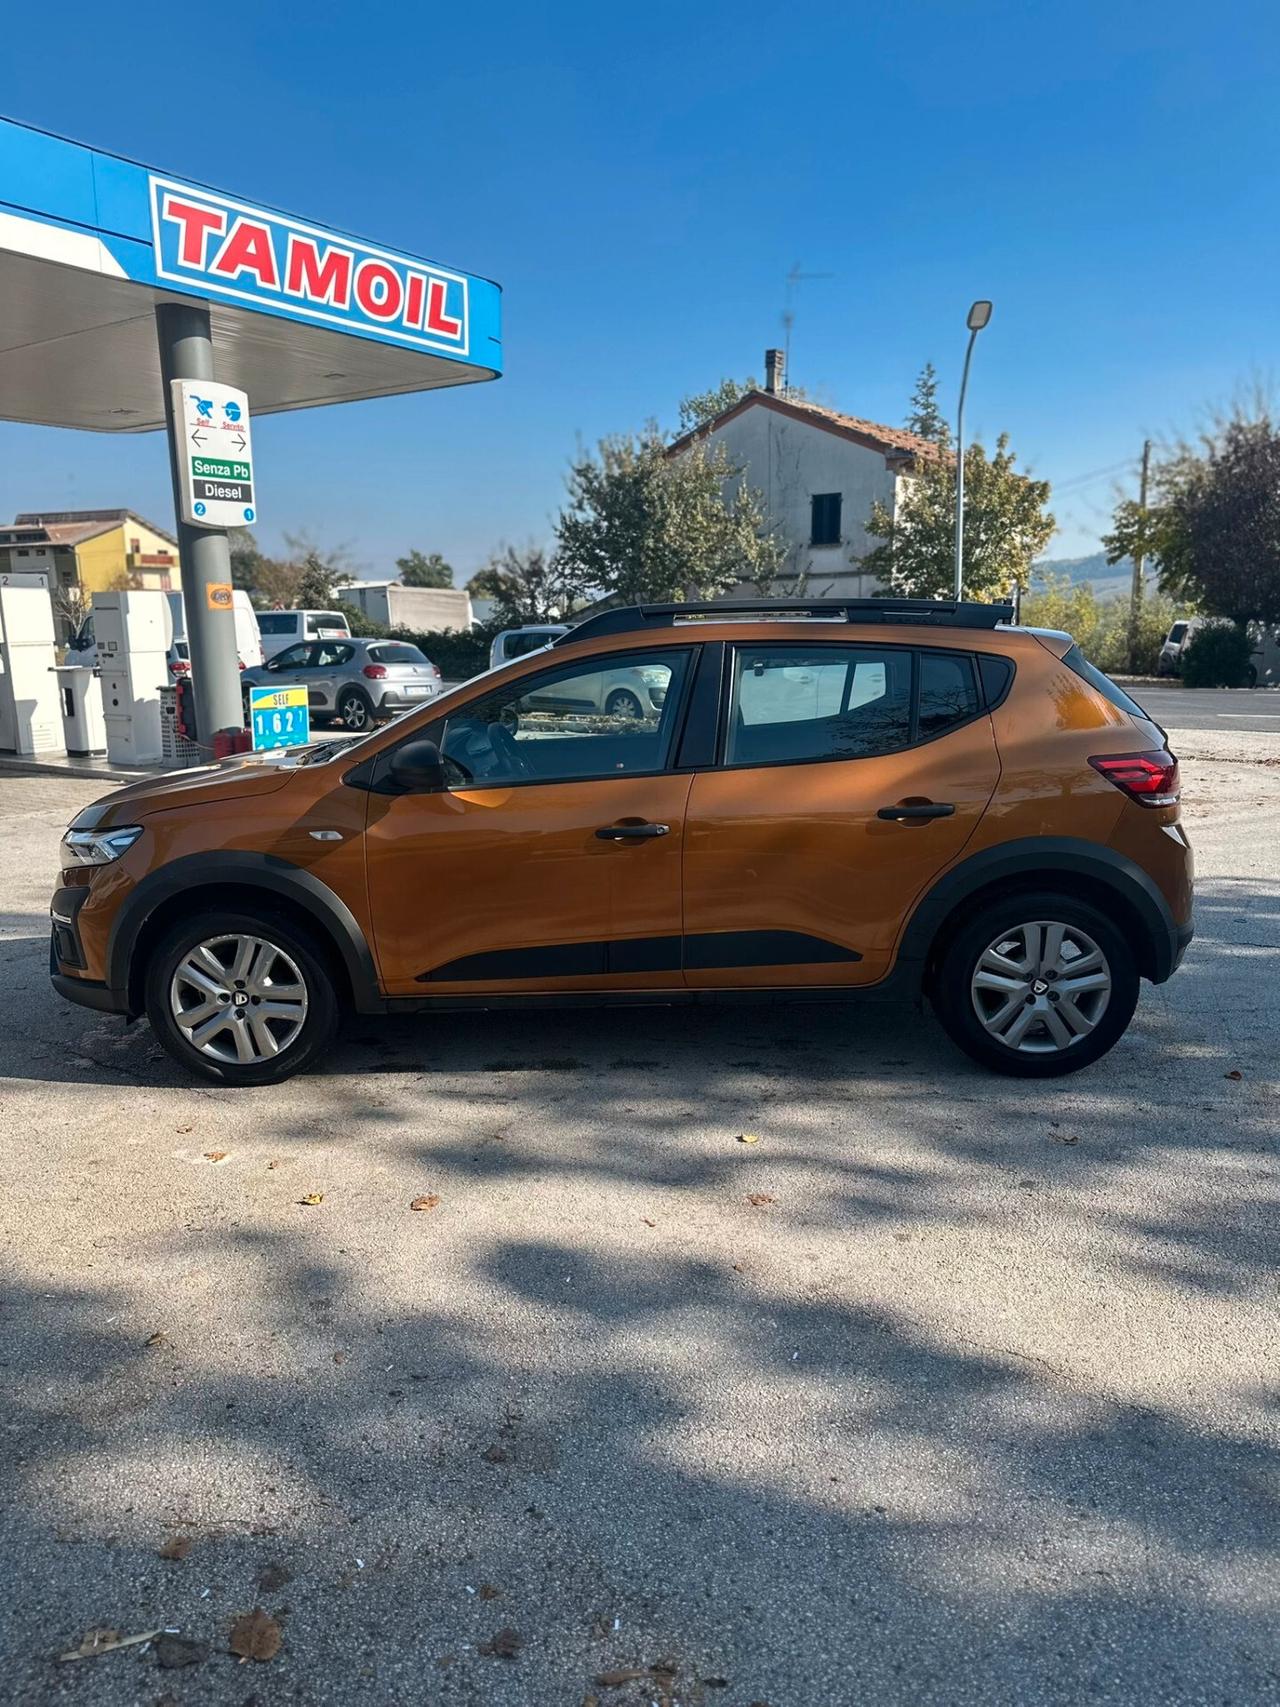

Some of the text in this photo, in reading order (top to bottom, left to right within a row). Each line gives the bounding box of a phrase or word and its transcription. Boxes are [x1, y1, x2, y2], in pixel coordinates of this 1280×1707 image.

[165, 196, 462, 338] TAMOIL
[197, 417, 210, 427] Self
[194, 460, 249, 478] Senza Pb
[205, 484, 242, 499] Diesel
[196, 504, 204, 515] 2
[2, 575, 9, 586] 2
[39, 576, 45, 586] 1
[272, 693, 289, 706] SELF
